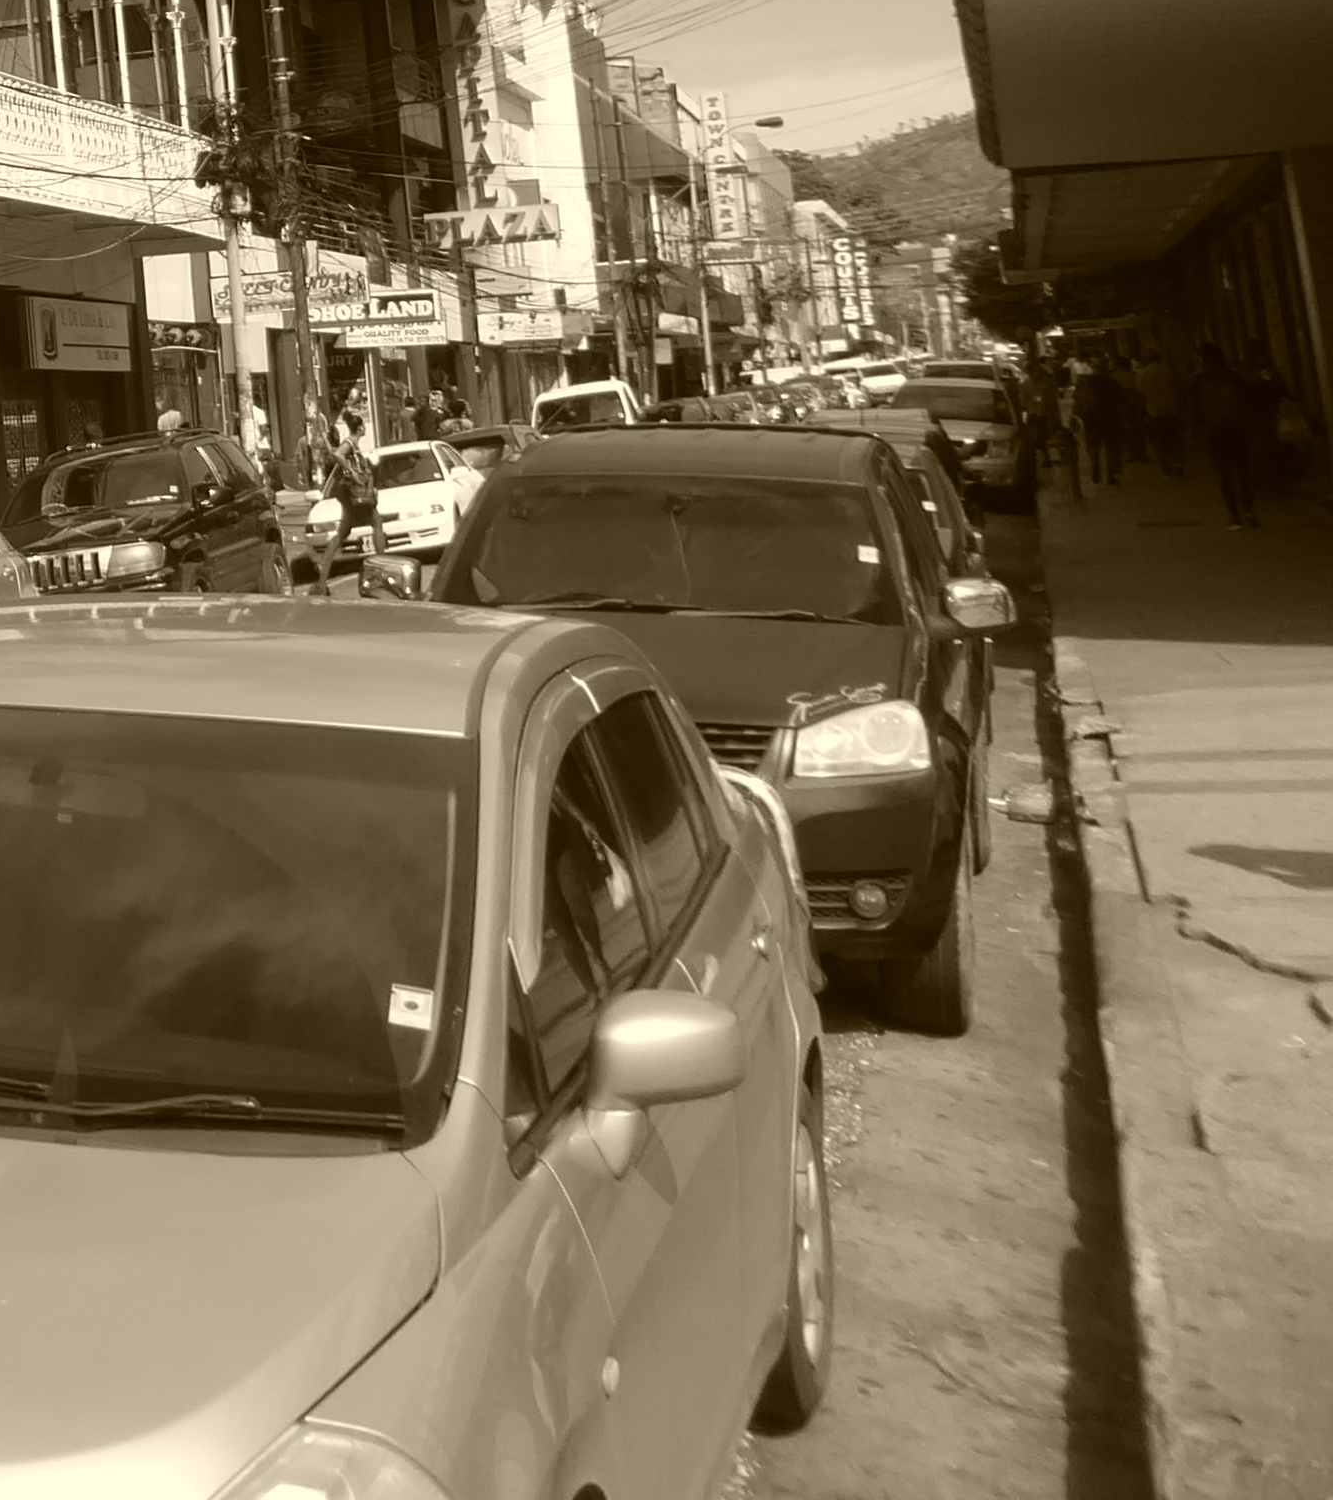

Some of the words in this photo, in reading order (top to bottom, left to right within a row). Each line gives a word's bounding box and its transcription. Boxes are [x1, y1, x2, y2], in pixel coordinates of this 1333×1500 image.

[423, 209, 559, 248] PLAZA
[308, 302, 366, 323] SHOE
[368, 297, 435, 319] LAND
[363, 330, 401, 338] QUALITY
